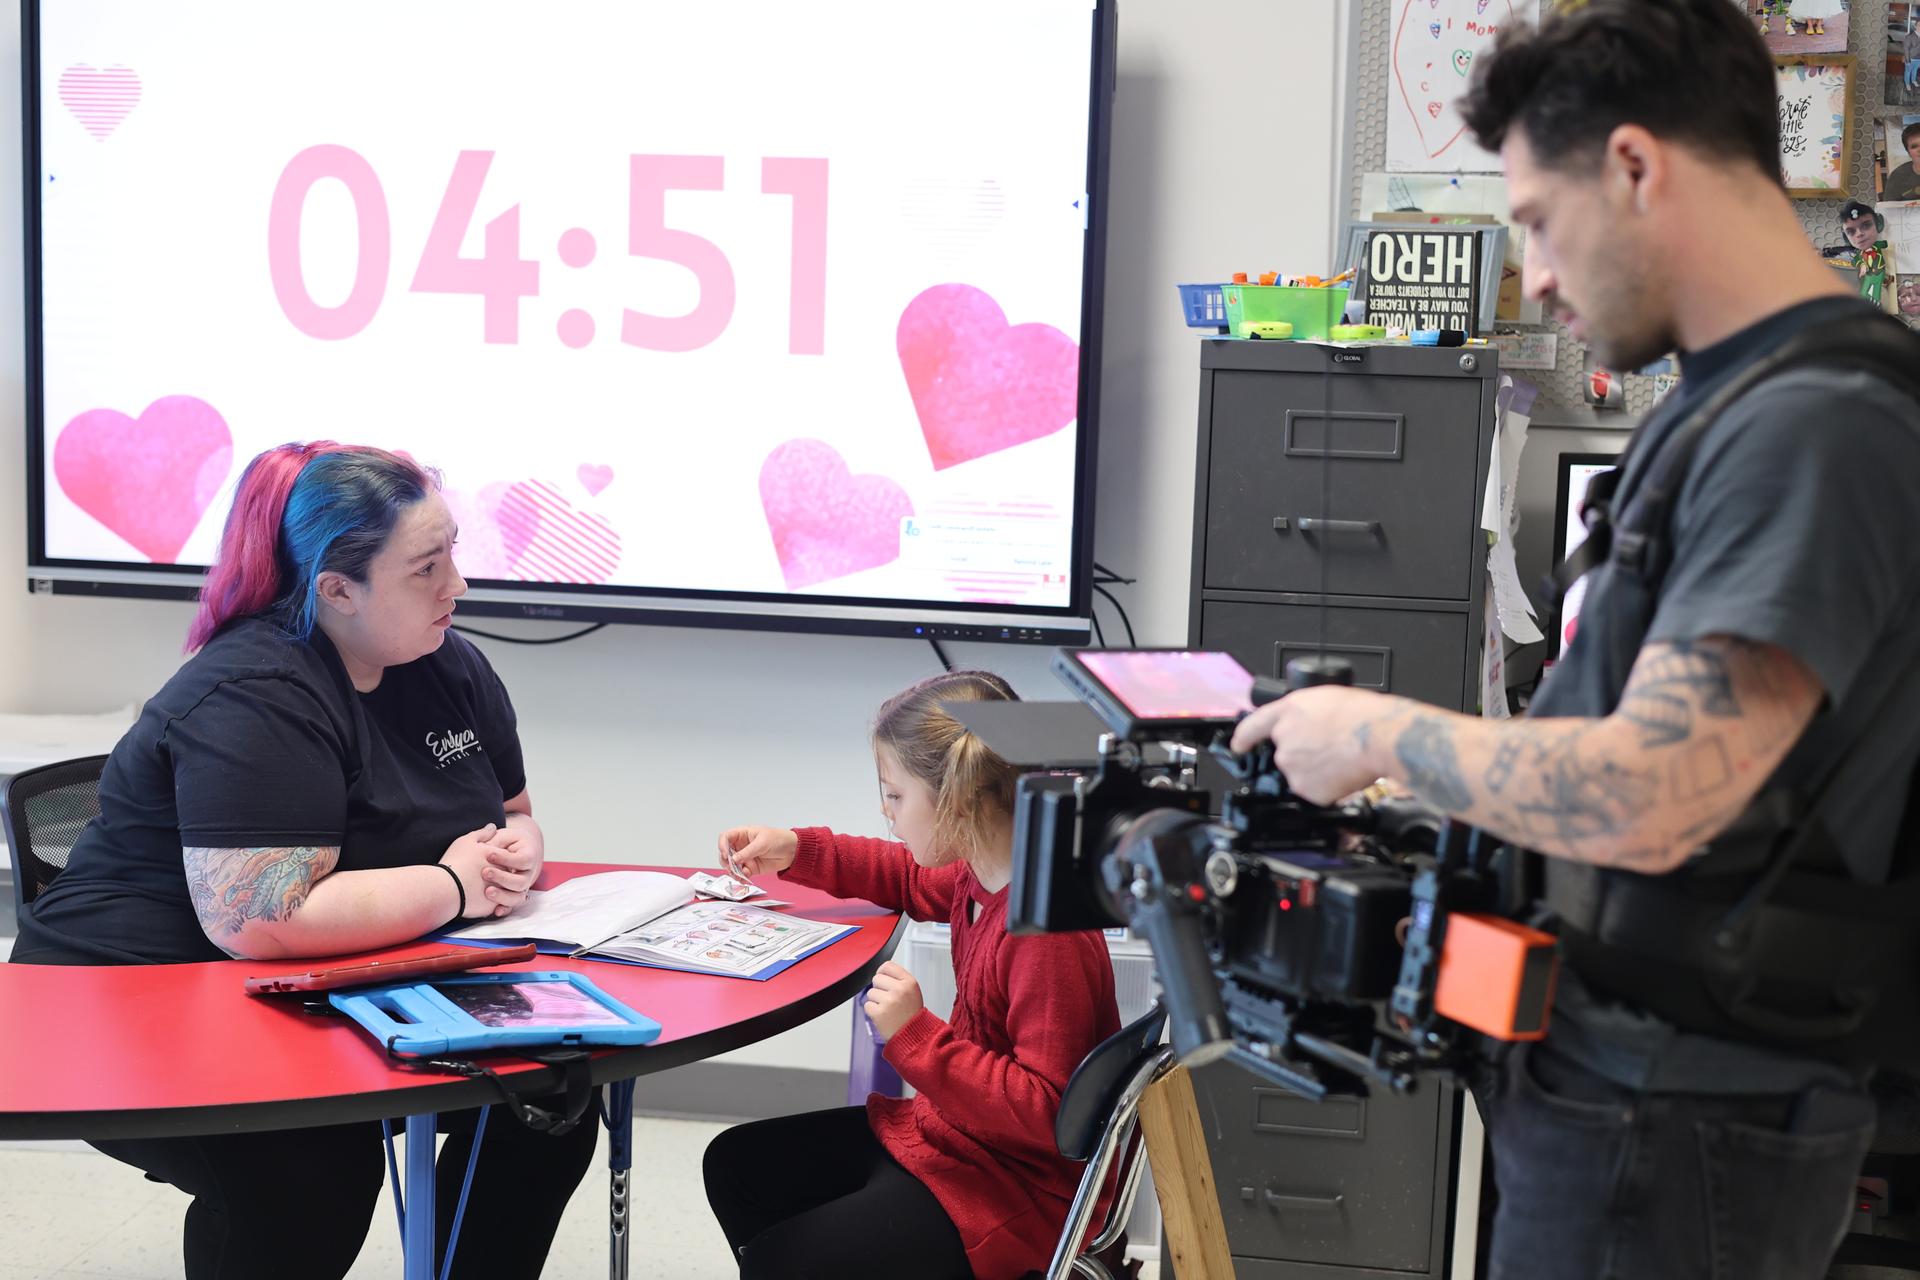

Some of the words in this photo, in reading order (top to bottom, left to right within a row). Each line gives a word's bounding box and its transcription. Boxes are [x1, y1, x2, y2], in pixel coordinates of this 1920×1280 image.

[1777, 95, 1810, 120] brate
[1780, 120, 1804, 133] ittle
[1779, 135, 1807, 153] ngs
[268, 143, 829, 355] 04:51
[1371, 233, 1472, 283] HERO
[1369, 284, 1375, 296] A
[1398, 285, 1429, 298] STUDENTS
[1430, 286, 1447, 298] YOUR
[1447, 286, 1456, 298] TO
[1458, 286, 1470, 298] BUT
[1369, 298, 1408, 311] TEACHER
[1410, 299, 1416, 311] A
[1417, 300, 1429, 311] BE
[1430, 300, 1449, 312] MAY
[1451, 301, 1469, 313] YOU
